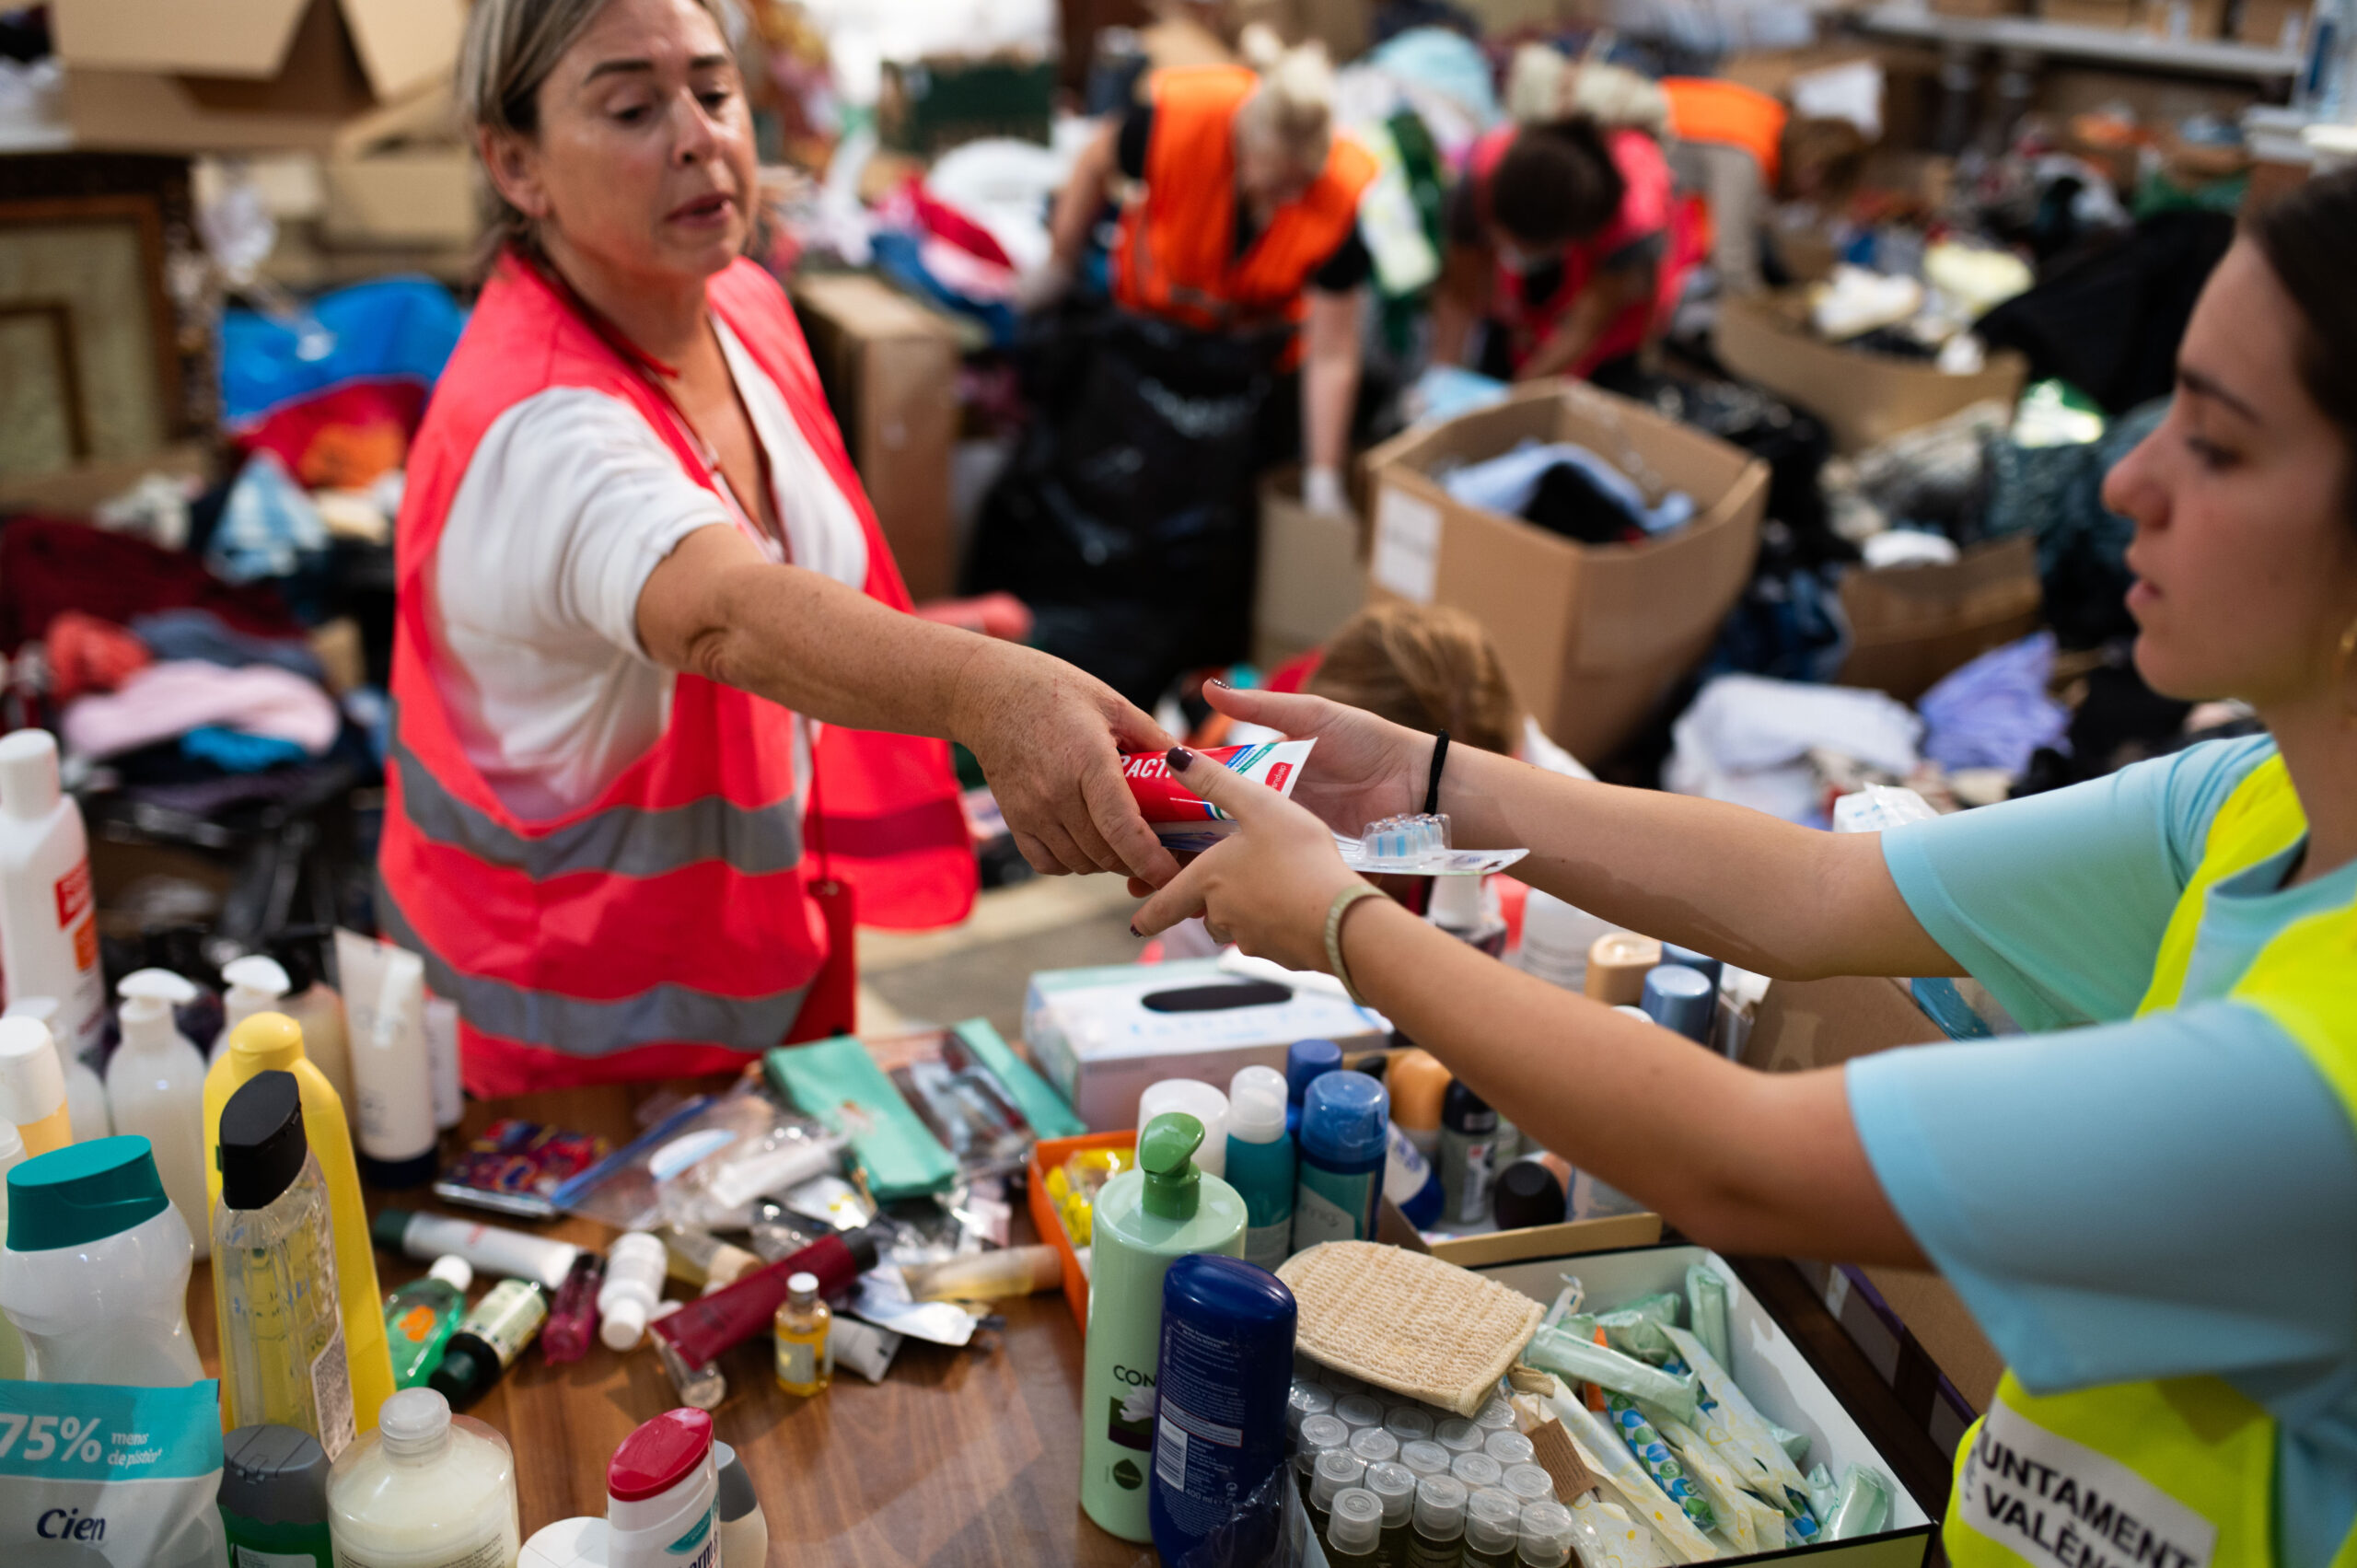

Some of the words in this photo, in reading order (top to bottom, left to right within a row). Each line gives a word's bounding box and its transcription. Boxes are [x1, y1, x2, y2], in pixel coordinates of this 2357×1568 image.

[0, 1412, 102, 1463] 75%
[37, 1507, 106, 1540] Cien
[1984, 1484, 2116, 1568] VALÈN
